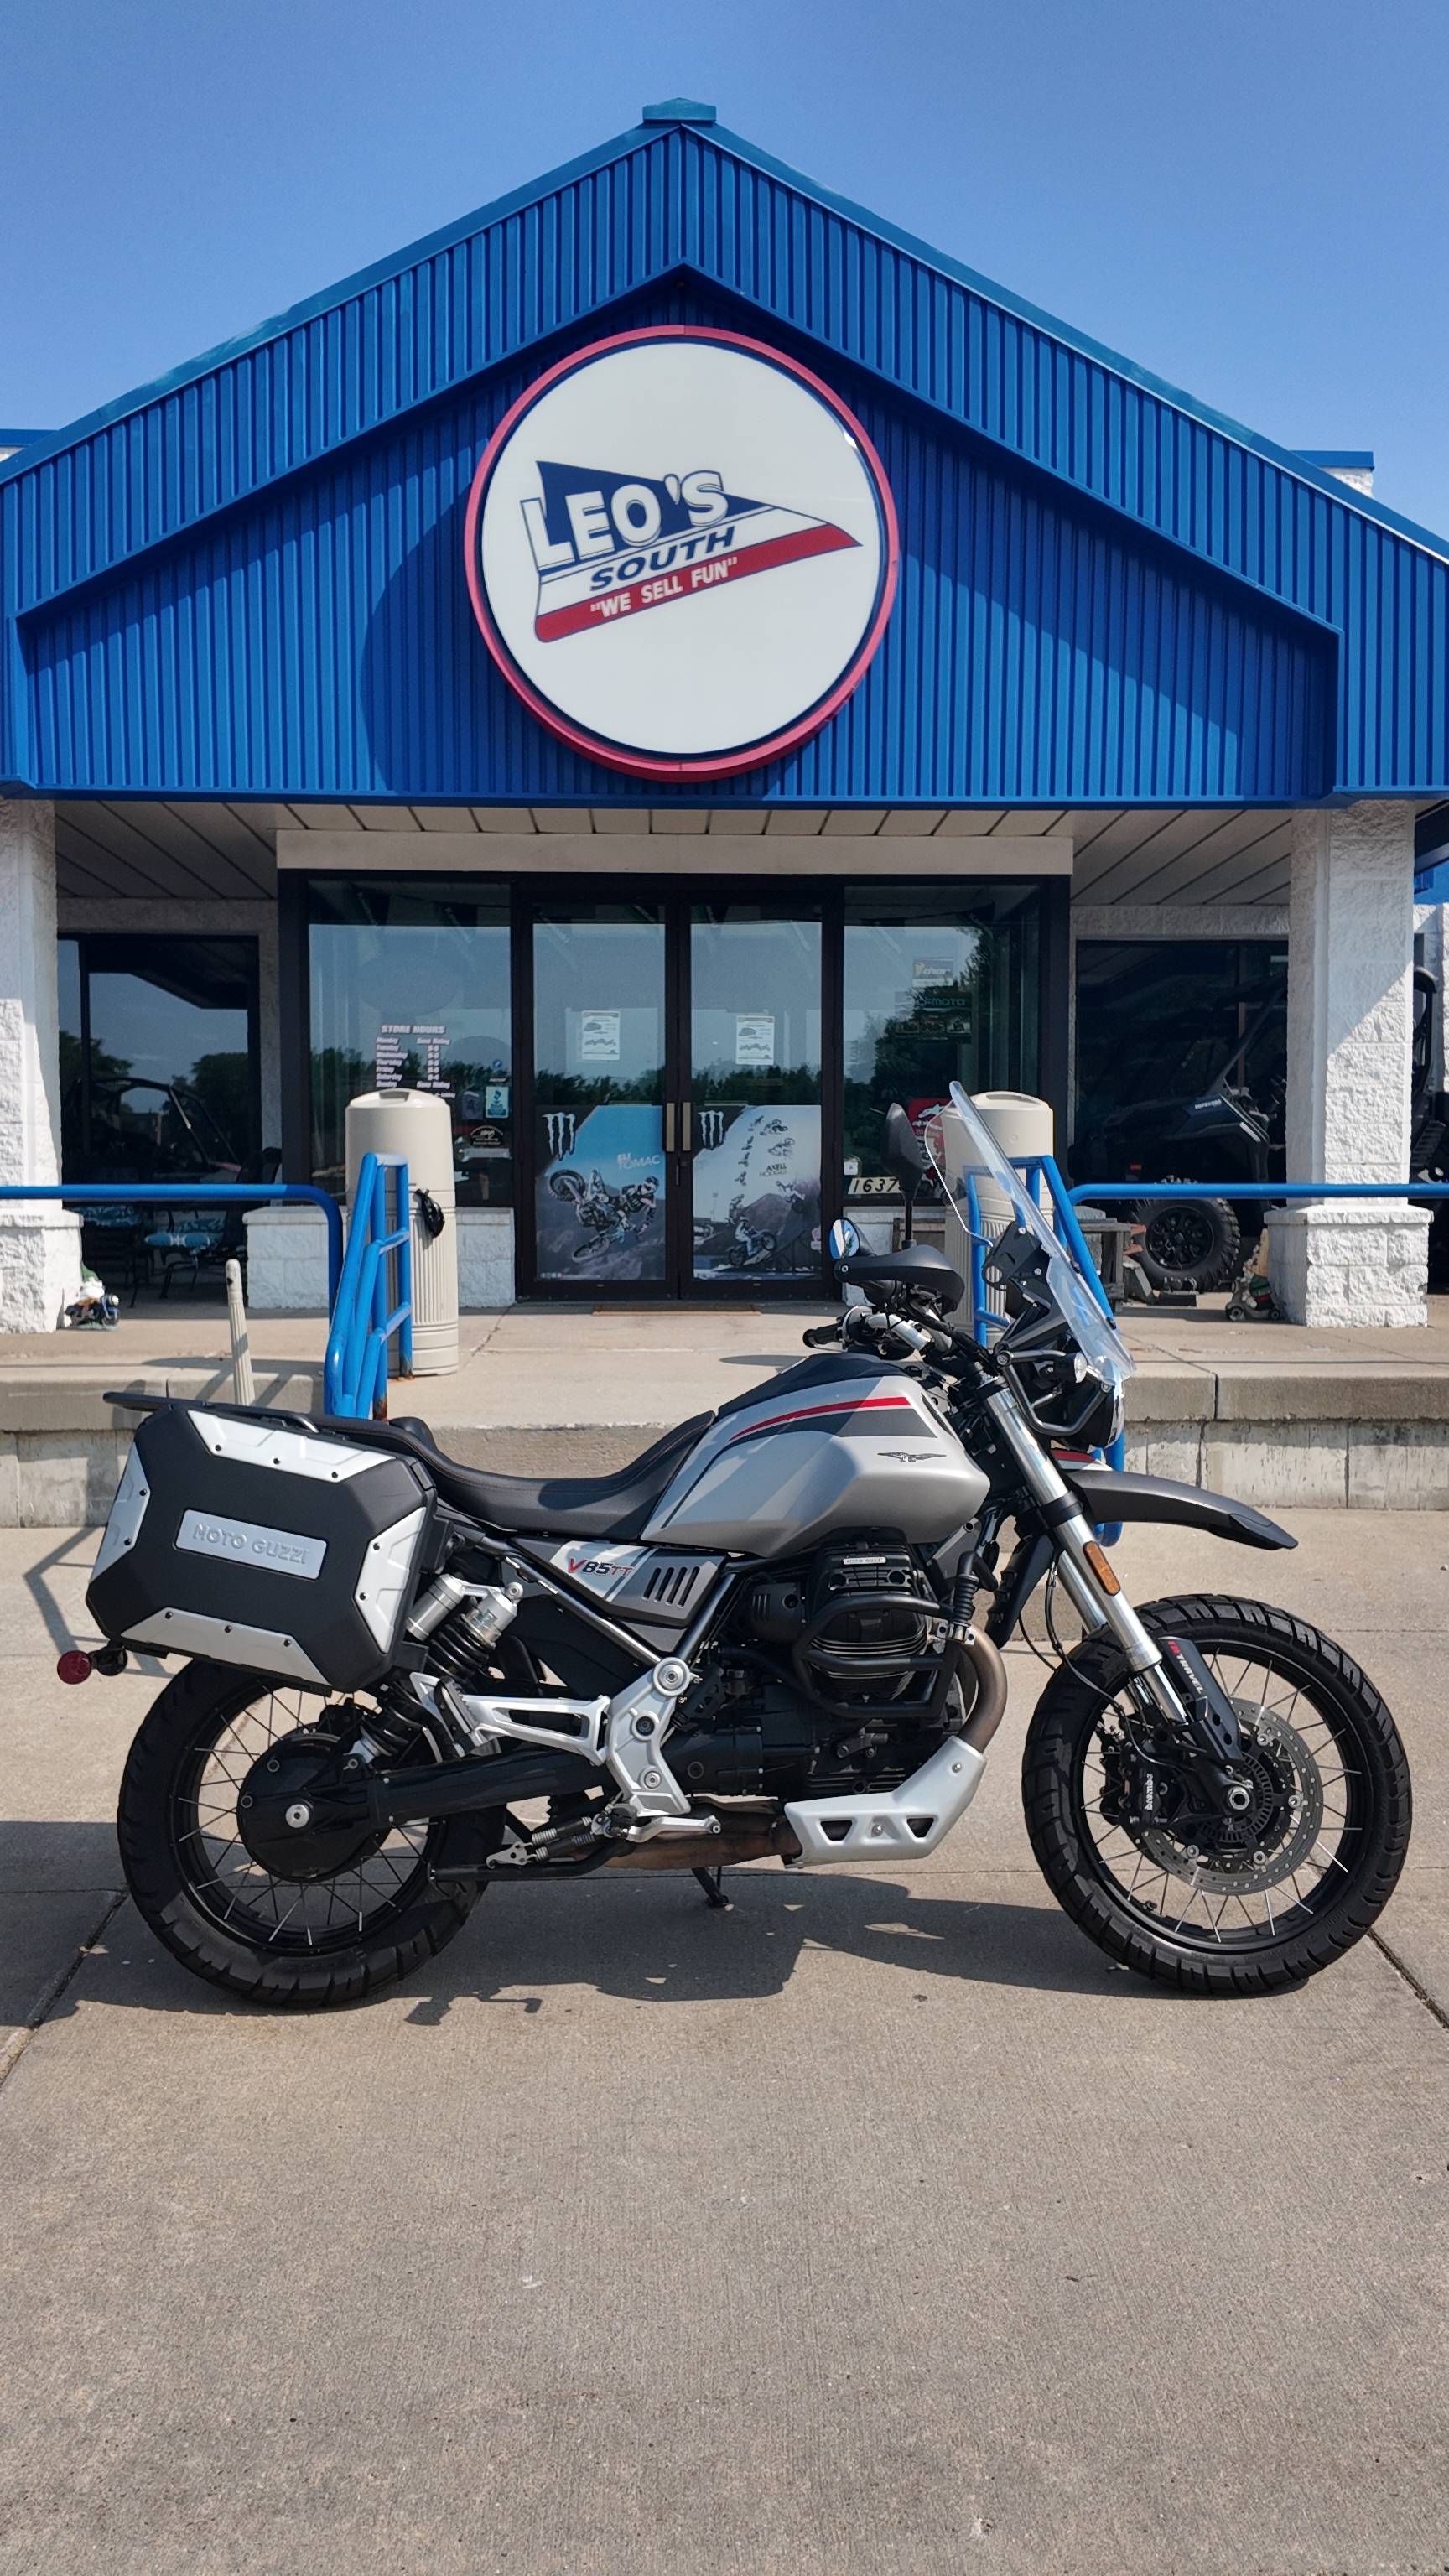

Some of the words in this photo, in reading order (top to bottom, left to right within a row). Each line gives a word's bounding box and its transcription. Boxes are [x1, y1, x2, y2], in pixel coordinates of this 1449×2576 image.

[519, 470, 730, 574] LEO'S
[589, 526, 735, 591] SOUTH
[641, 575, 683, 604] SELL
[380, 1024, 411, 1034] STORE
[412, 1024, 447, 1034] HOURS
[376, 1036, 400, 1045] Monday
[376, 1044, 400, 1052] Tuesday
[376, 1052, 408, 1060] Wednesday
[376, 1059, 403, 1067] Thursday
[376, 1066, 395, 1074] Friday
[376, 1073, 402, 1082] Saturday
[376, 1080, 398, 1088] Sunday
[616, 1152, 631, 1161] ELI
[617, 1154, 661, 1171] TOMAC
[853, 1178, 903, 1192] 1637
[193, 1523, 247, 1550] MOTO
[252, 1538, 310, 1565] GUZZI
[568, 1557, 636, 1577] V85TT
[1176, 1653, 1204, 1695] TRAVEL
[1144, 1773, 1154, 1810] brembo
